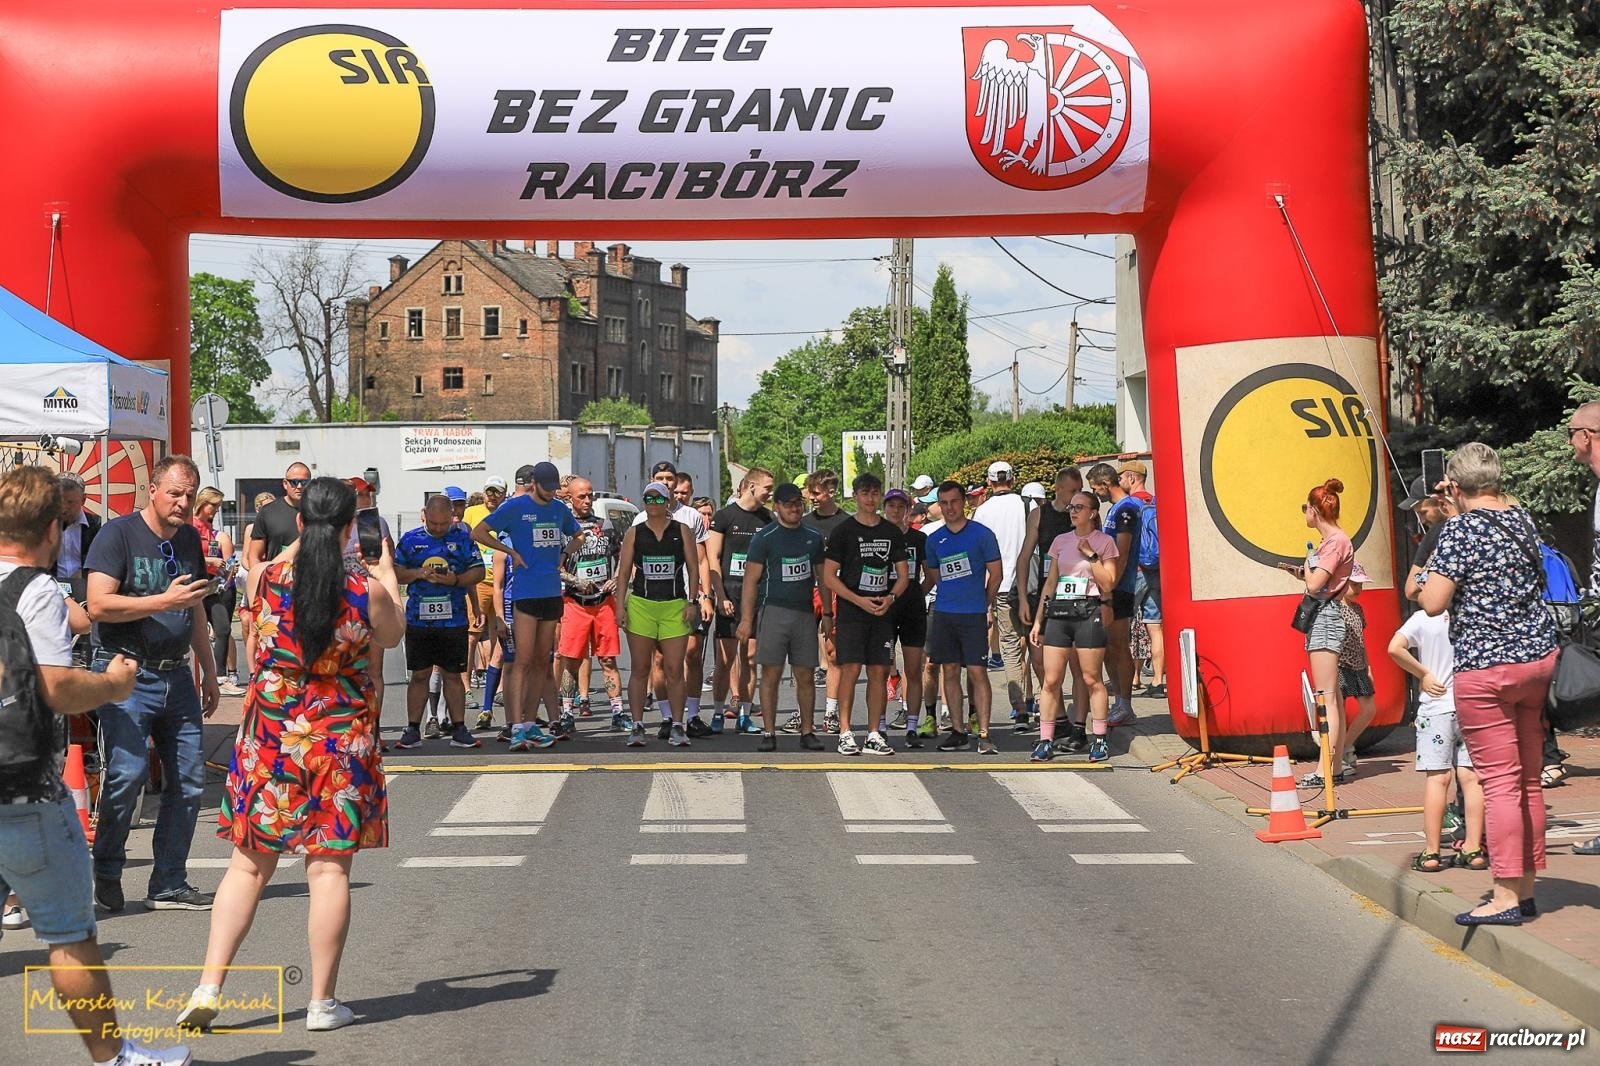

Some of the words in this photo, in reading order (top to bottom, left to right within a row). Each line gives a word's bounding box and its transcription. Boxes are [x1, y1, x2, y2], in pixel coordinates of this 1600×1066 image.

[607, 27, 773, 62] BIEG
[328, 48, 430, 84] SIR
[486, 89, 629, 134] BEZ
[638, 87, 893, 133] GRANIC
[519, 148, 860, 200] RACIBÓRZ
[43, 398, 78, 409] MITKO
[1290, 396, 1373, 438] SIR
[412, 427, 440, 437] TRWA
[404, 437, 431, 446] Sekcja
[433, 437, 482, 446] Podnoszenia
[404, 446, 439, 454] Ciężarów
[541, 529, 555, 539] 98
[586, 566, 601, 577] 94
[649, 563, 669, 573] 102
[788, 563, 806, 575] 100
[946, 561, 962, 573] 85
[869, 575, 885, 585] 110
[1064, 583, 1077, 594] 81
[428, 603, 444, 613] 83
